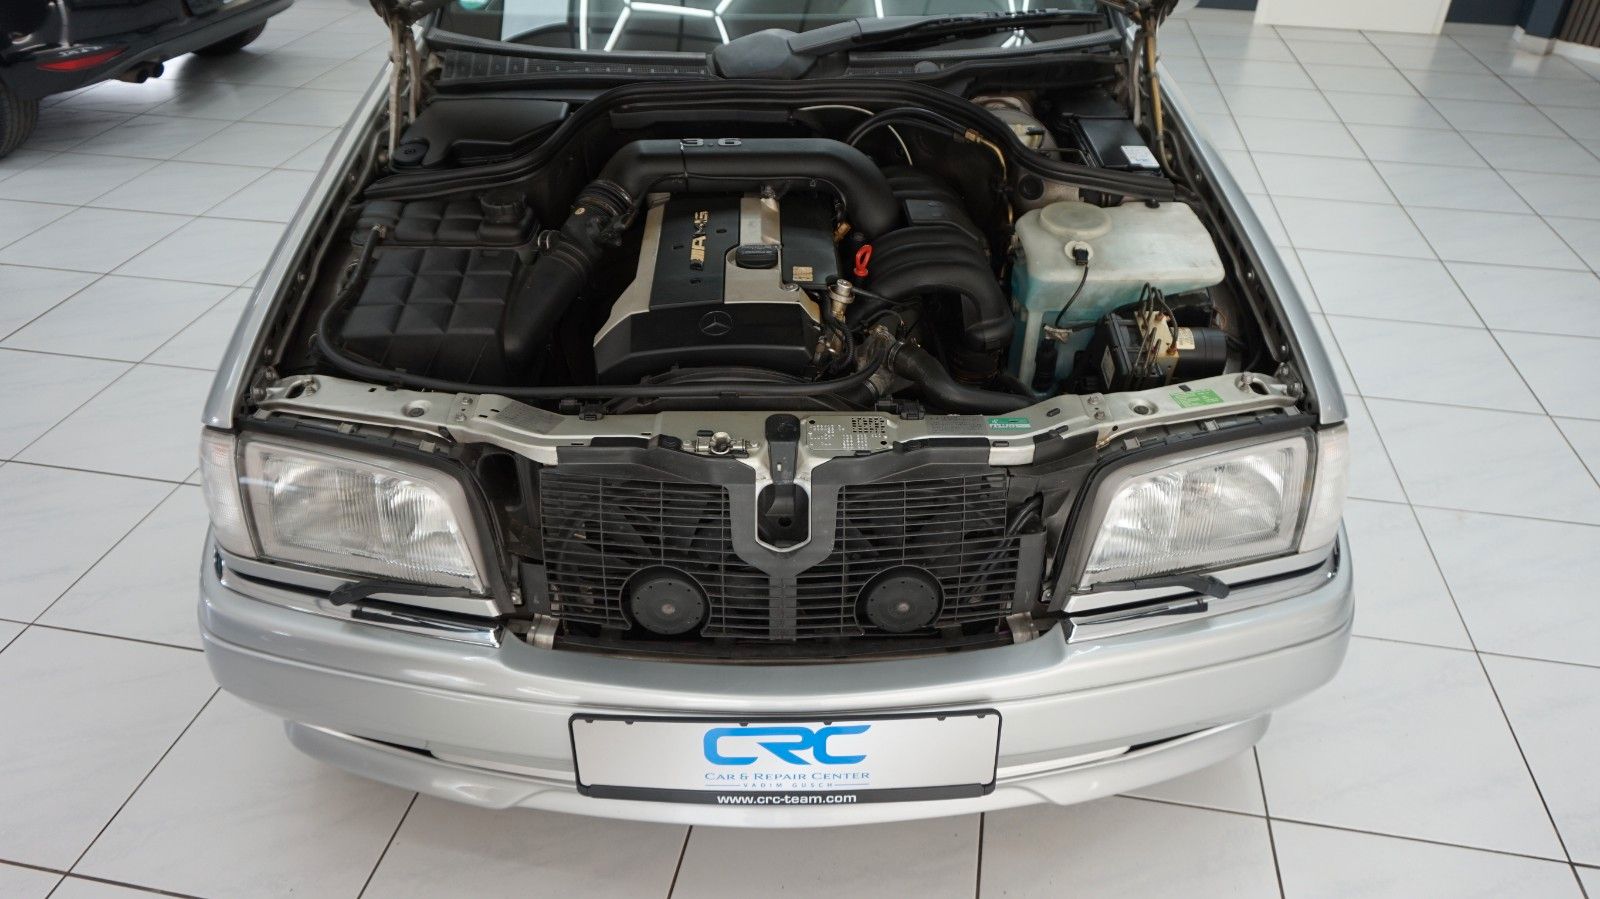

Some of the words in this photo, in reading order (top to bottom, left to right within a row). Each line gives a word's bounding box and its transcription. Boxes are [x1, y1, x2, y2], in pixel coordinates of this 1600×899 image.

[703, 724, 871, 766] CRC
[704, 772, 735, 781] CAR
[740, 772, 748, 781] &
[754, 772, 807, 780] REPAIR
[811, 772, 870, 780] CENTER
[717, 794, 857, 805] www.crc-team.com
